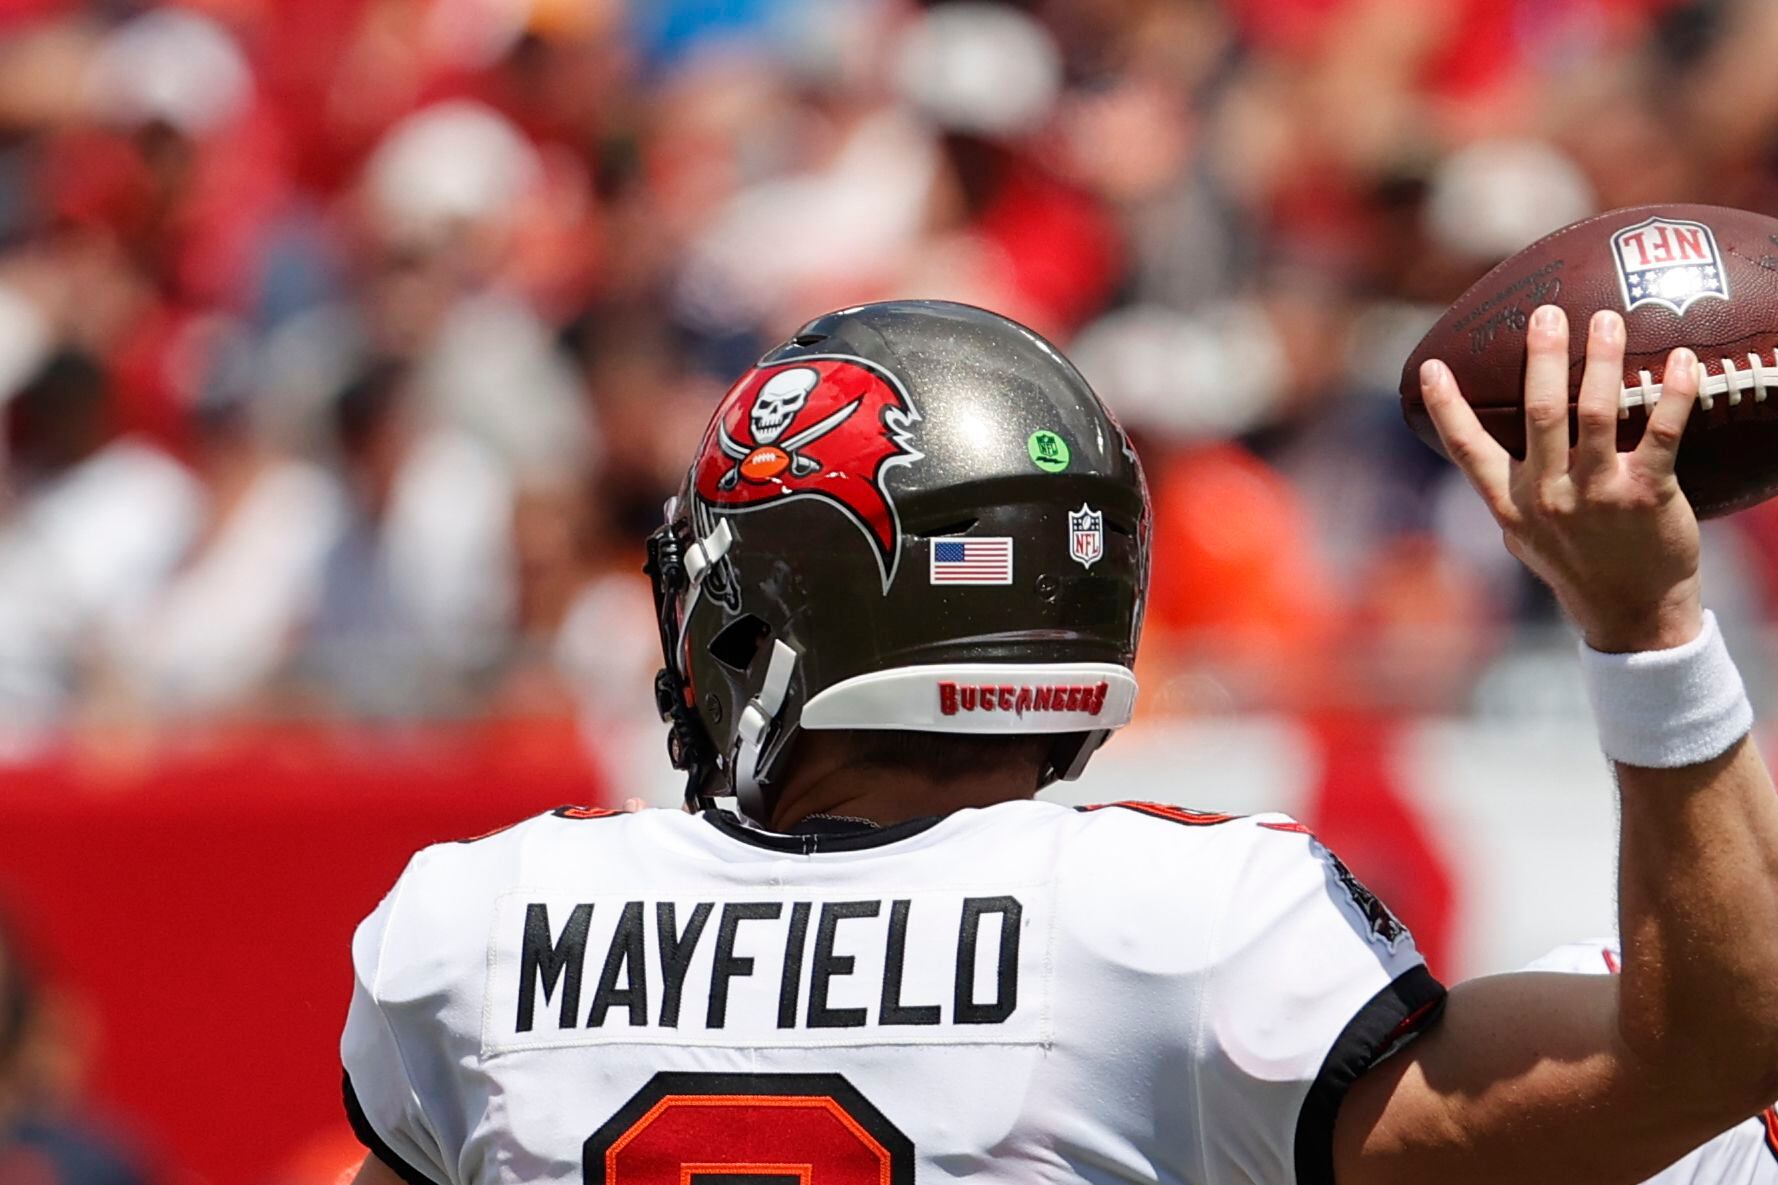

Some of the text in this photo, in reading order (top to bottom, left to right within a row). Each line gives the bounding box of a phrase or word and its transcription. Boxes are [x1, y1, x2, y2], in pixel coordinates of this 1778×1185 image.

[1622, 226, 1707, 266] NFL
[1075, 533, 1099, 554] NFL
[937, 681, 1109, 720] BUCCANEERS
[515, 895, 1022, 1032] MAYFIELD
